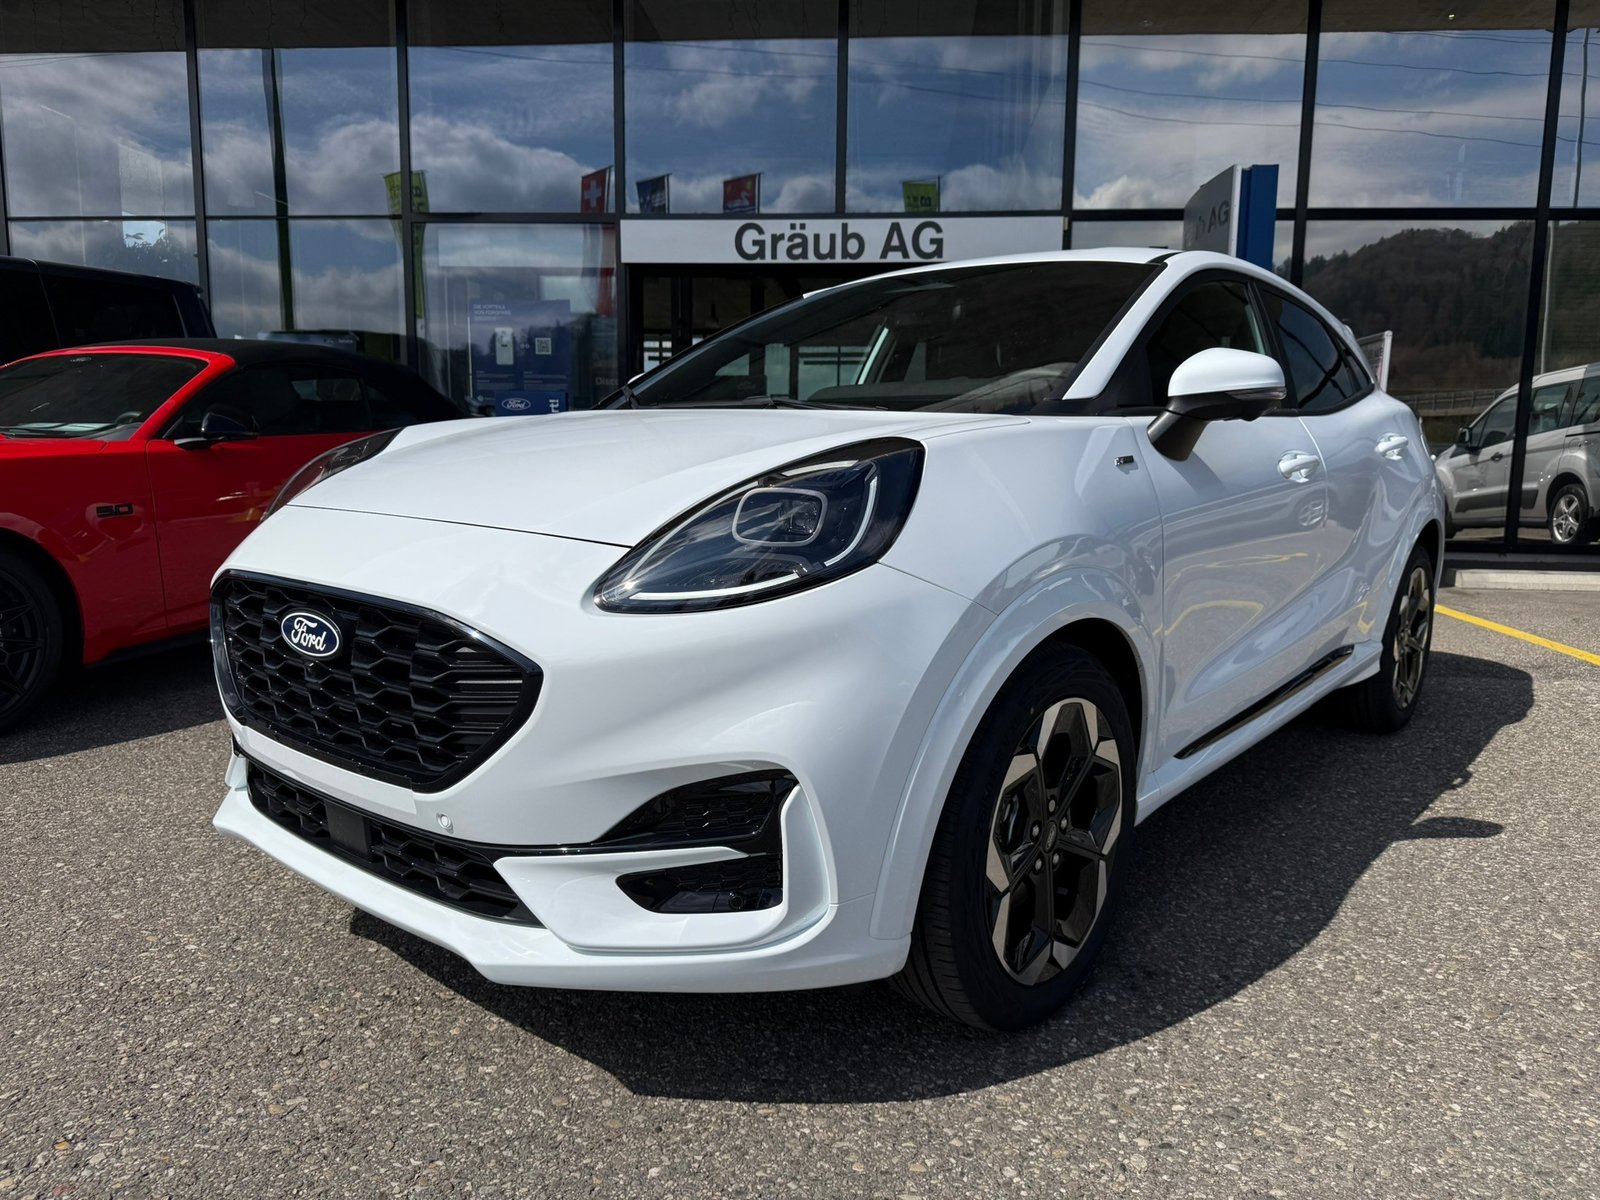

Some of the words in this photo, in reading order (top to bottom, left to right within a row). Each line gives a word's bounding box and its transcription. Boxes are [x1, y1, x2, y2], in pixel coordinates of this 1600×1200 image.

[734, 222, 866, 261] Gräub
[879, 221, 944, 260] AG
[291, 617, 327, 651] Ford
